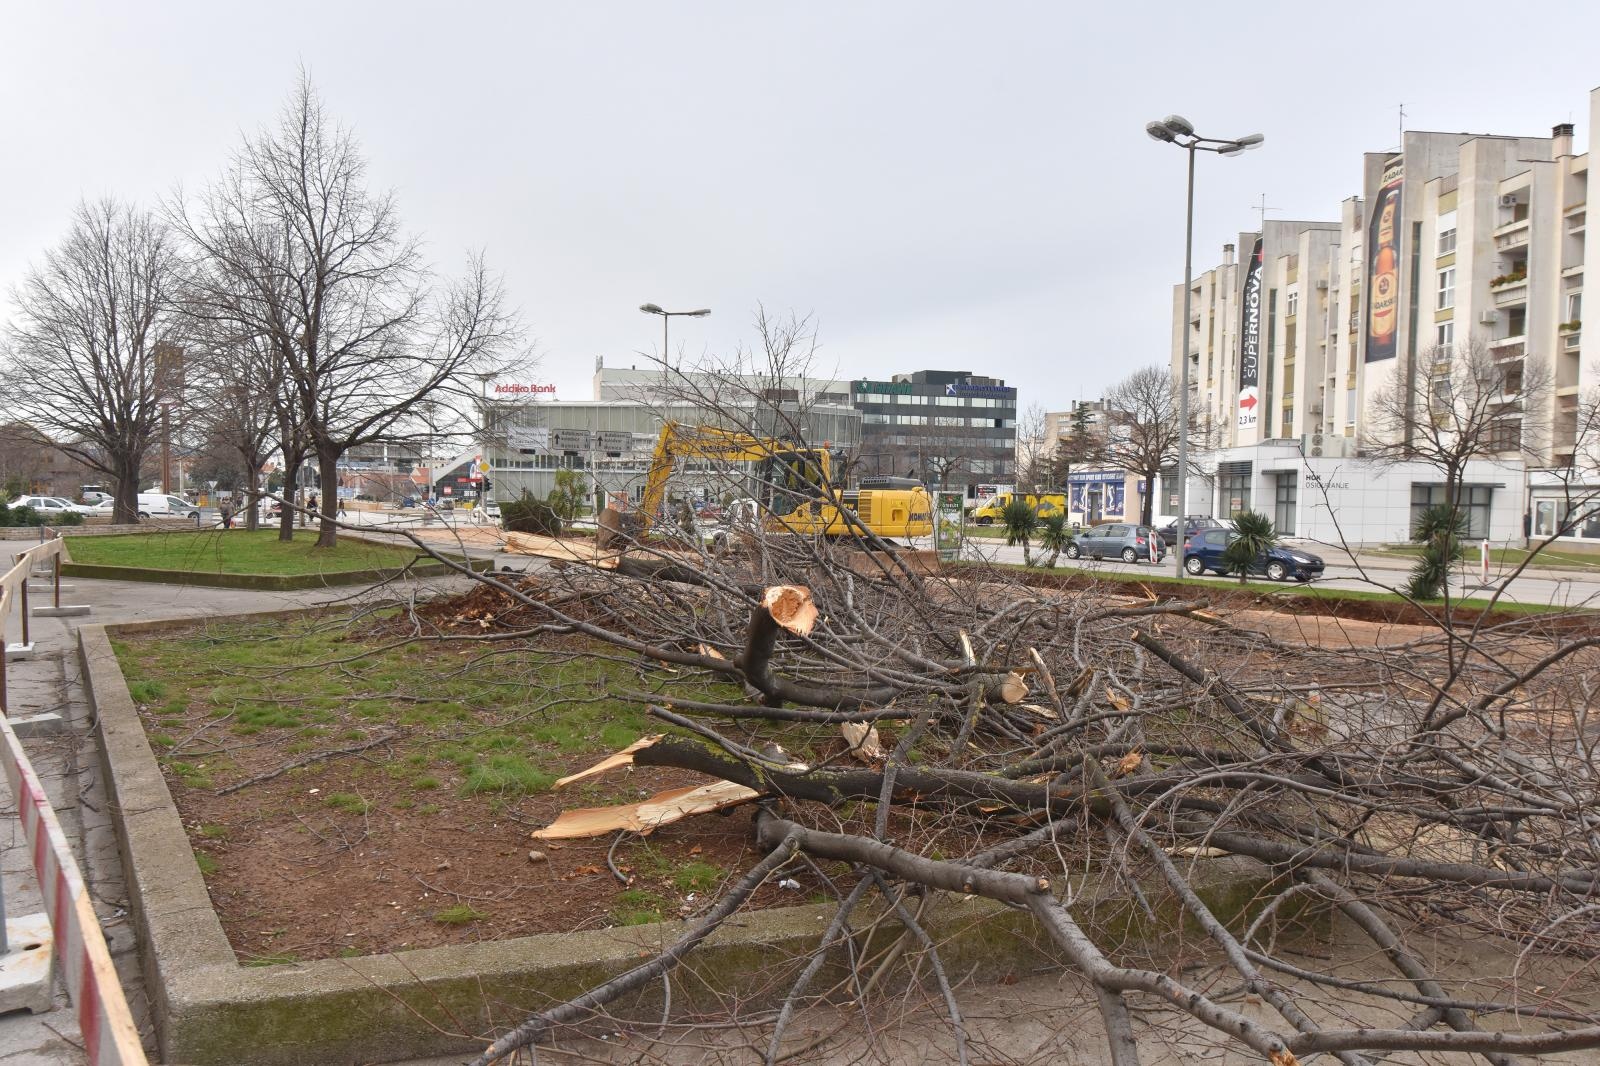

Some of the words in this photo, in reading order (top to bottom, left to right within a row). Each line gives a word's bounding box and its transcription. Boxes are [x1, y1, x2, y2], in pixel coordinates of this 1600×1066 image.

[1247, 266, 1262, 378] SUPERNOVA
[495, 383, 529, 393] Addiko
[531, 383, 556, 393] Bank
